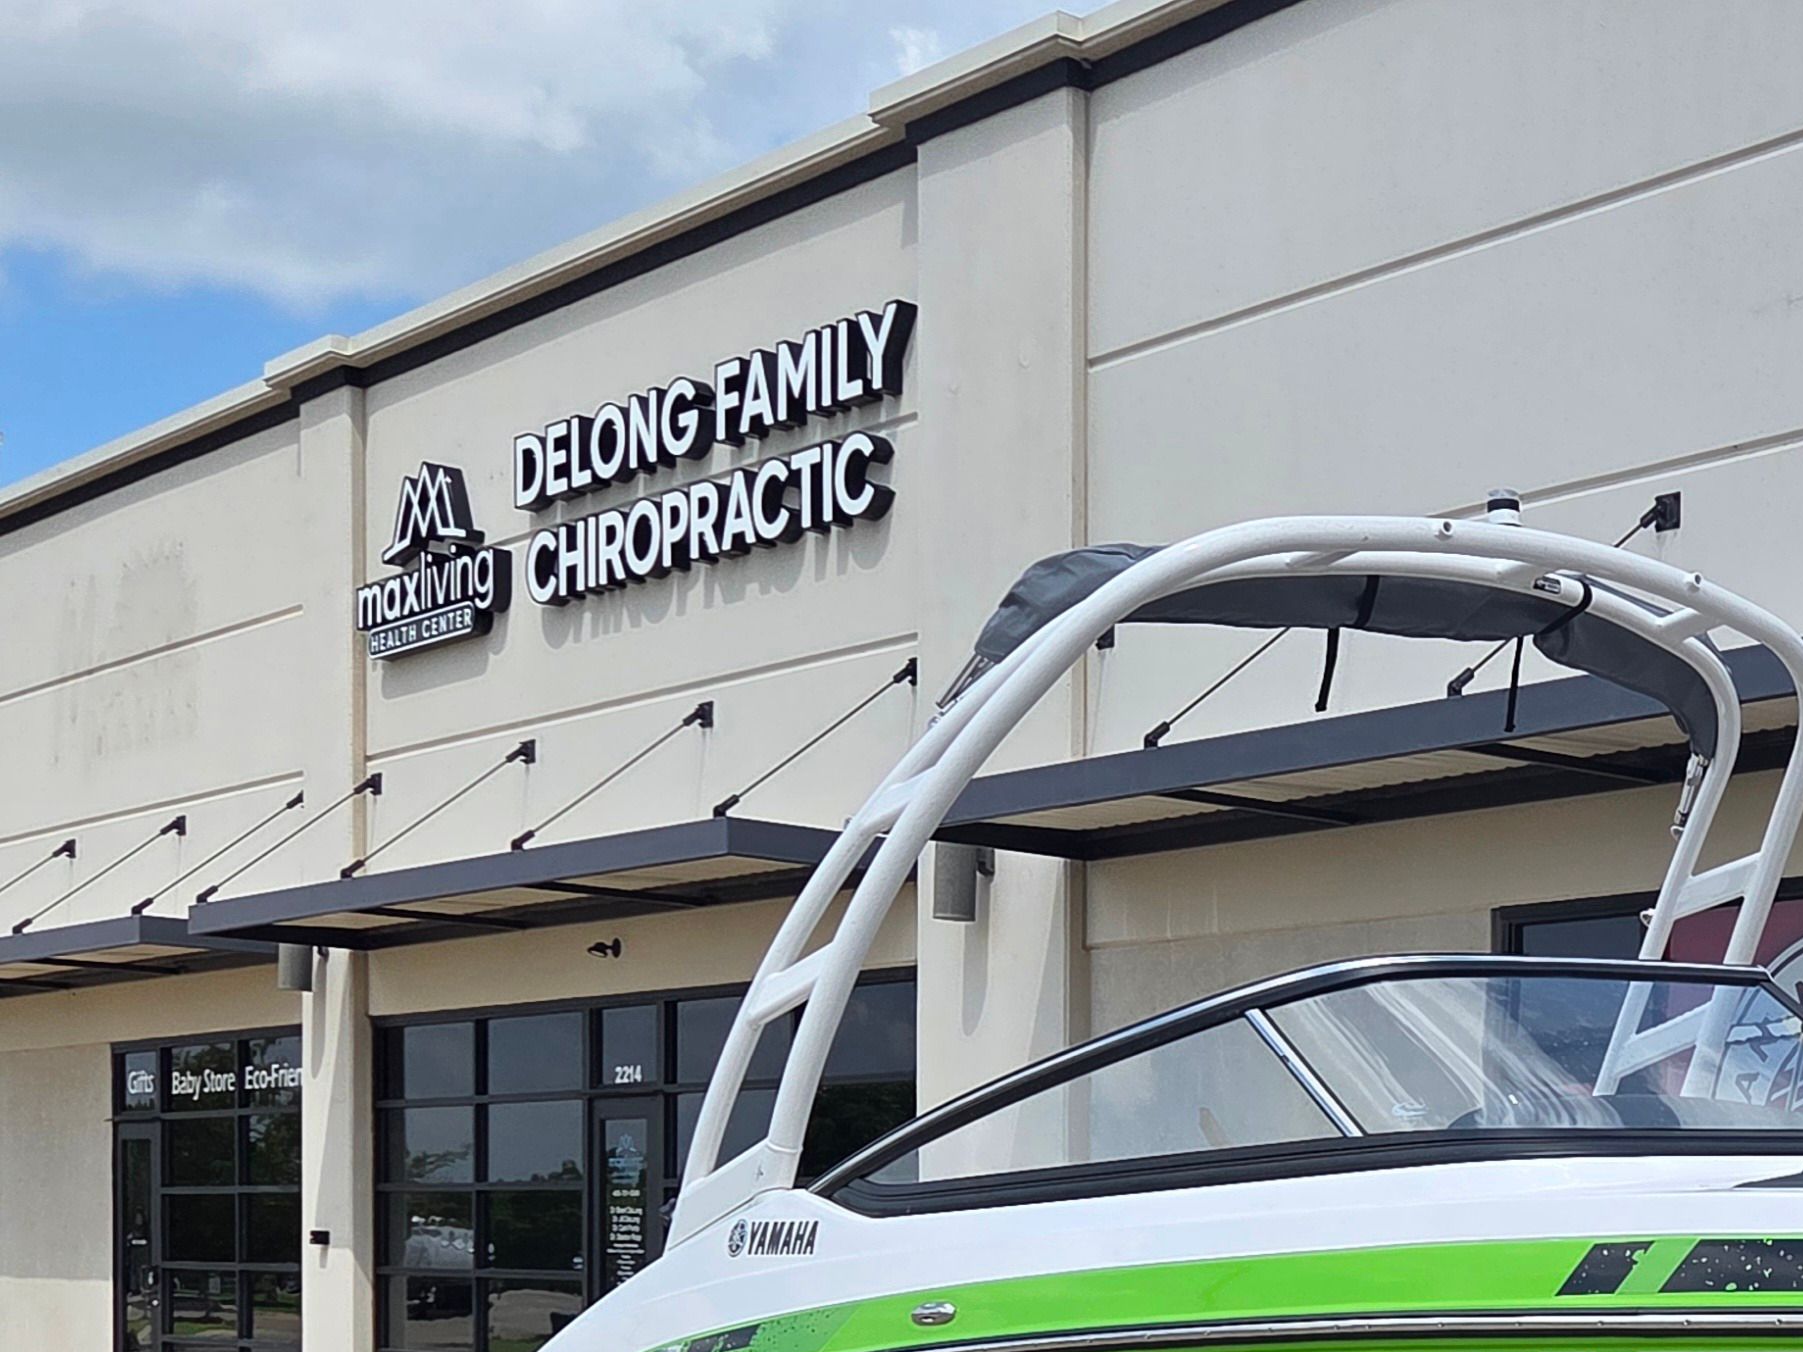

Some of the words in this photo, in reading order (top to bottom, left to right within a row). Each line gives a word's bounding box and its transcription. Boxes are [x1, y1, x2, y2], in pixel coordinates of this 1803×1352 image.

[513, 378, 700, 509] DELONG
[715, 300, 899, 441] FAMILY
[526, 432, 876, 603] CHIROPRACTIC
[357, 544, 494, 629] maxliving
[370, 624, 417, 653] HEALTH
[421, 608, 473, 638] CENTER
[127, 1069, 155, 1094] Gifts
[171, 1071, 201, 1101] Baby
[203, 1068, 236, 1094] Store
[614, 1064, 642, 1084] 2214
[747, 1220, 819, 1256] YAMAHA
